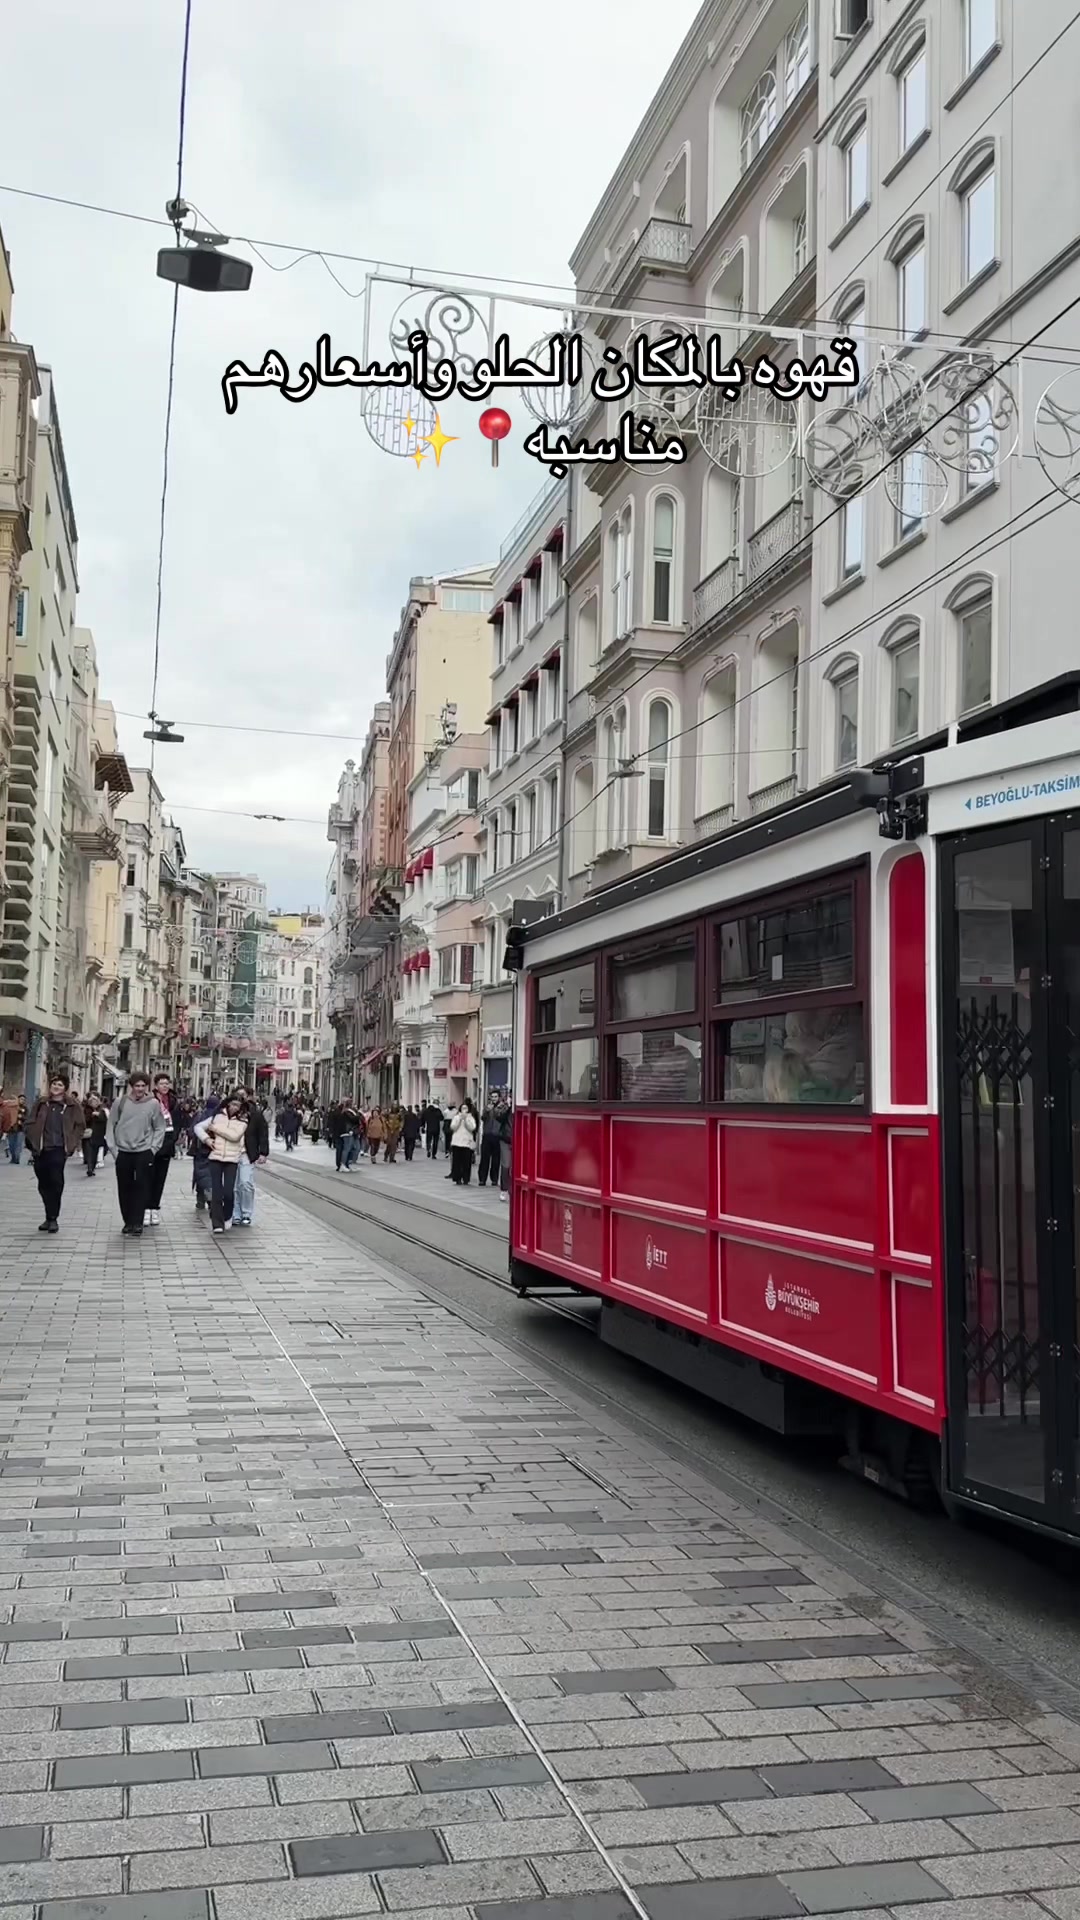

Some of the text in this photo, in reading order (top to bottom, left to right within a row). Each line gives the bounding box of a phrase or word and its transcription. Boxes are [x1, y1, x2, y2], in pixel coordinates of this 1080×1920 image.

[975, 774, 1080, 809] BEYOĞLU-TAKSİM
[653, 1245, 668, 1264] İETT
[777, 1287, 820, 1314] BÜYÜKŞEHİR
